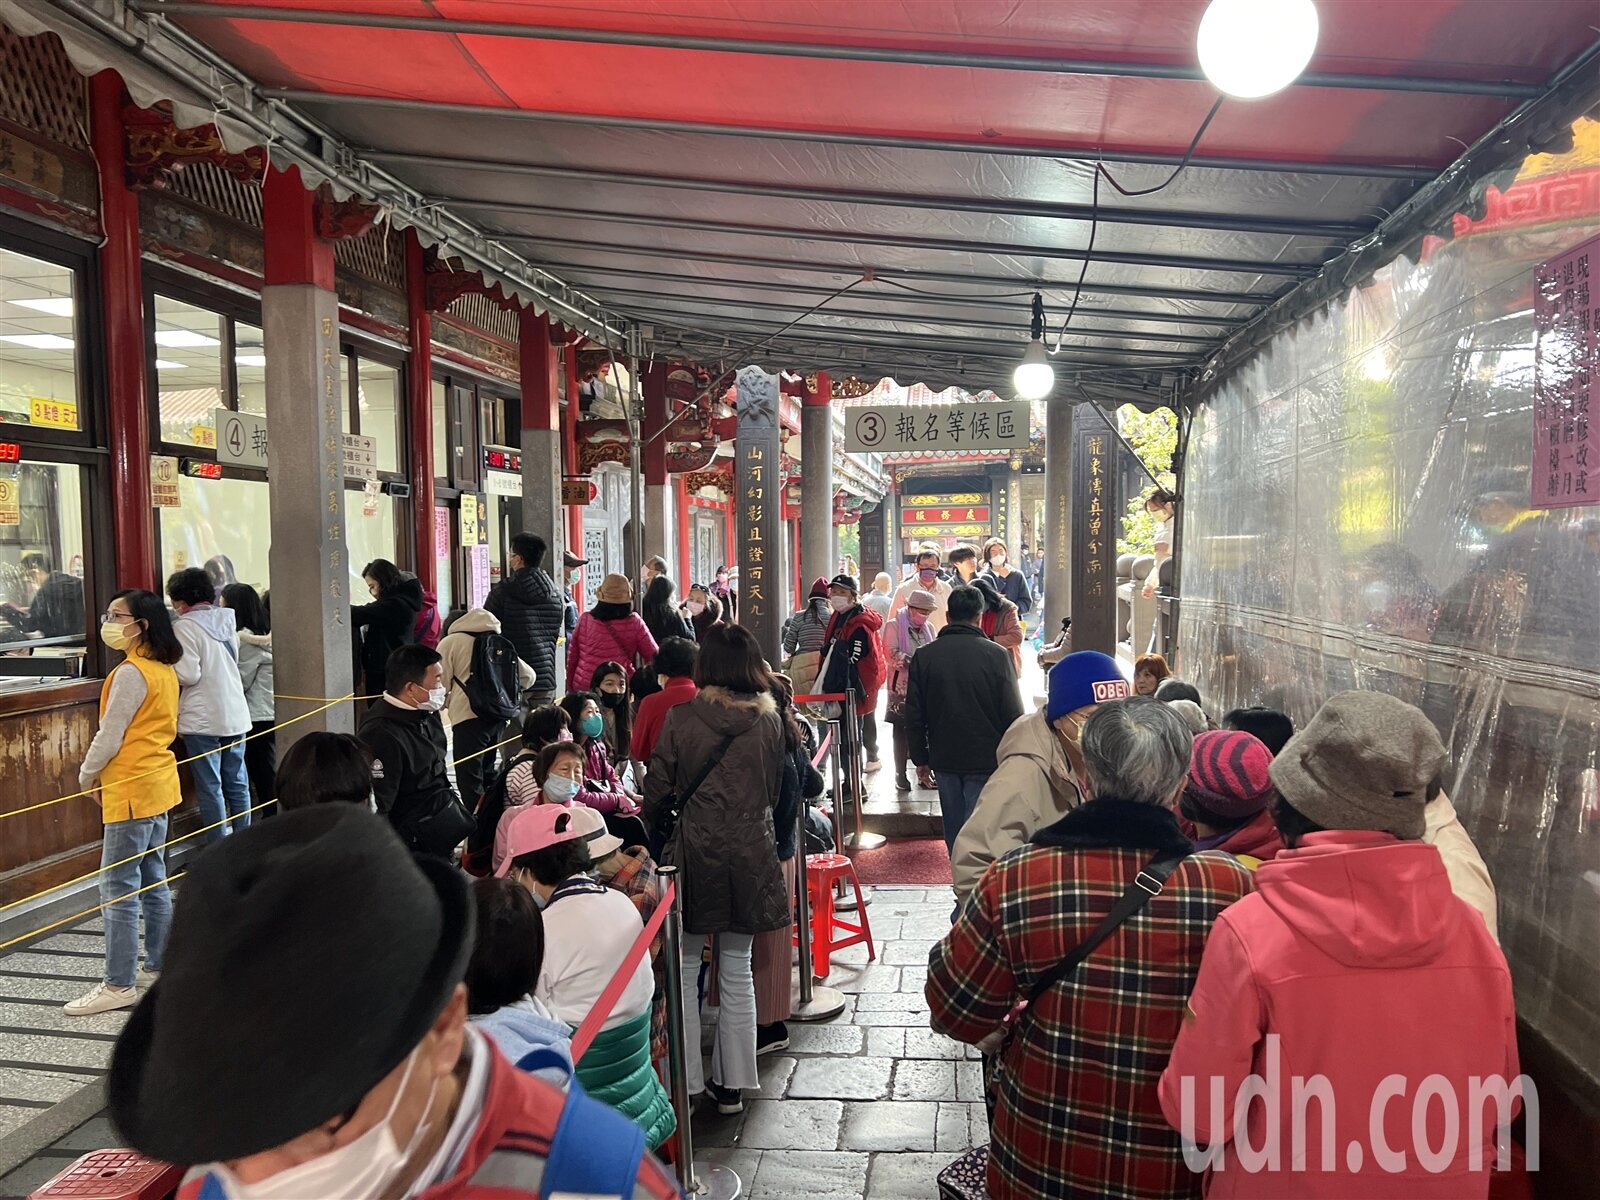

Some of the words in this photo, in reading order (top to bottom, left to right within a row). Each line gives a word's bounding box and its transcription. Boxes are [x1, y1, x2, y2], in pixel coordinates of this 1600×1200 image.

[895, 410, 1016, 443] 報名等候區
[916, 508, 976, 521] 服務處
